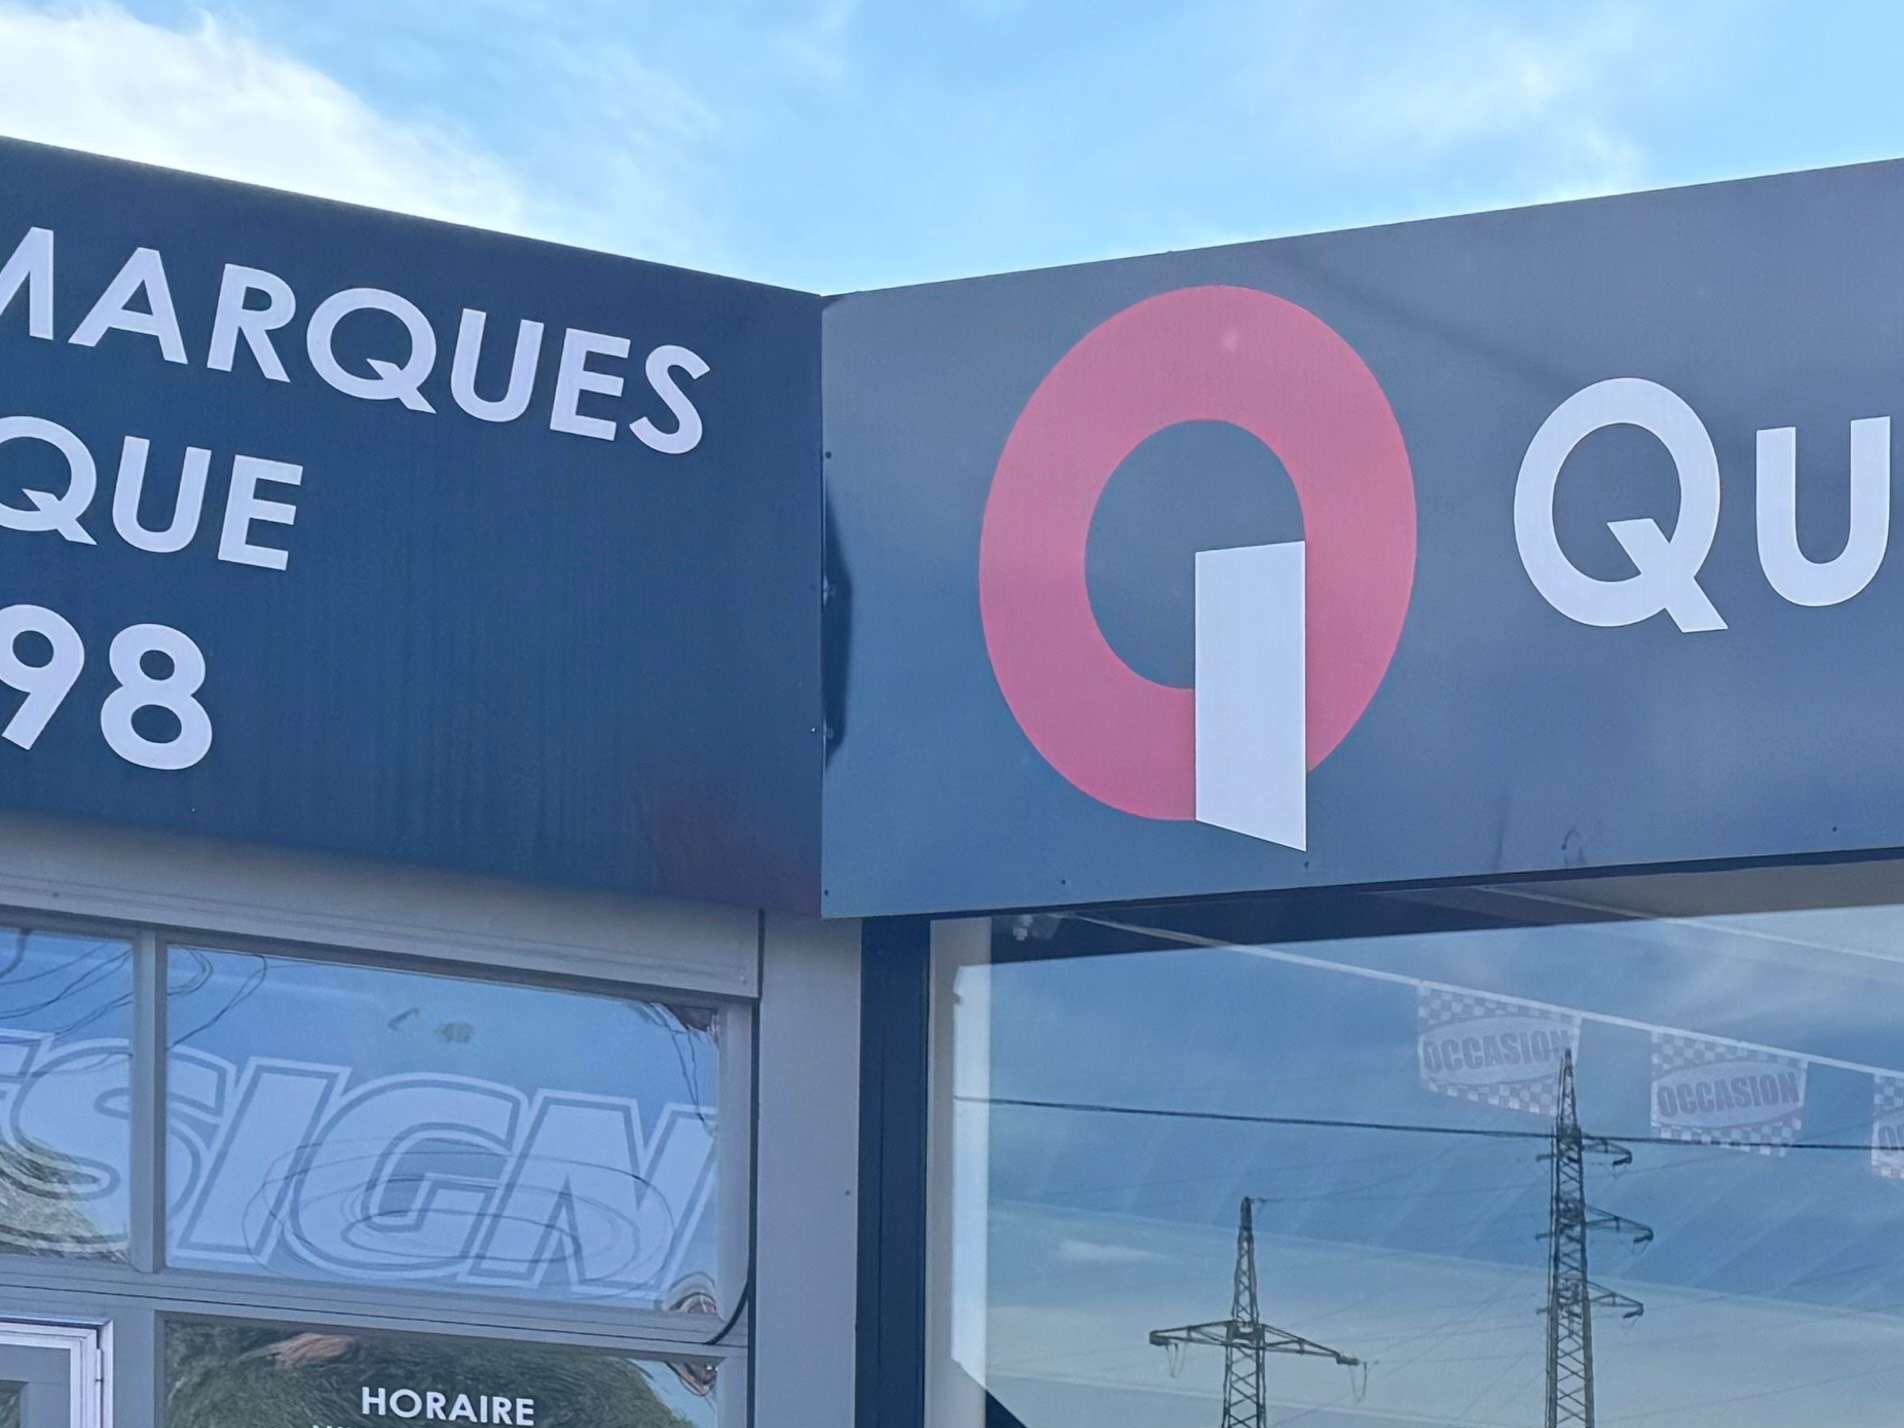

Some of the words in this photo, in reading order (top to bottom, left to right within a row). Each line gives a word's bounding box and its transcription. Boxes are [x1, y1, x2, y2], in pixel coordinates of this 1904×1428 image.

[1657, 1071, 1799, 1119] OCCASION
[0, 1028, 718, 1297] SIGN
[361, 1386, 535, 1427] HORAIRE
